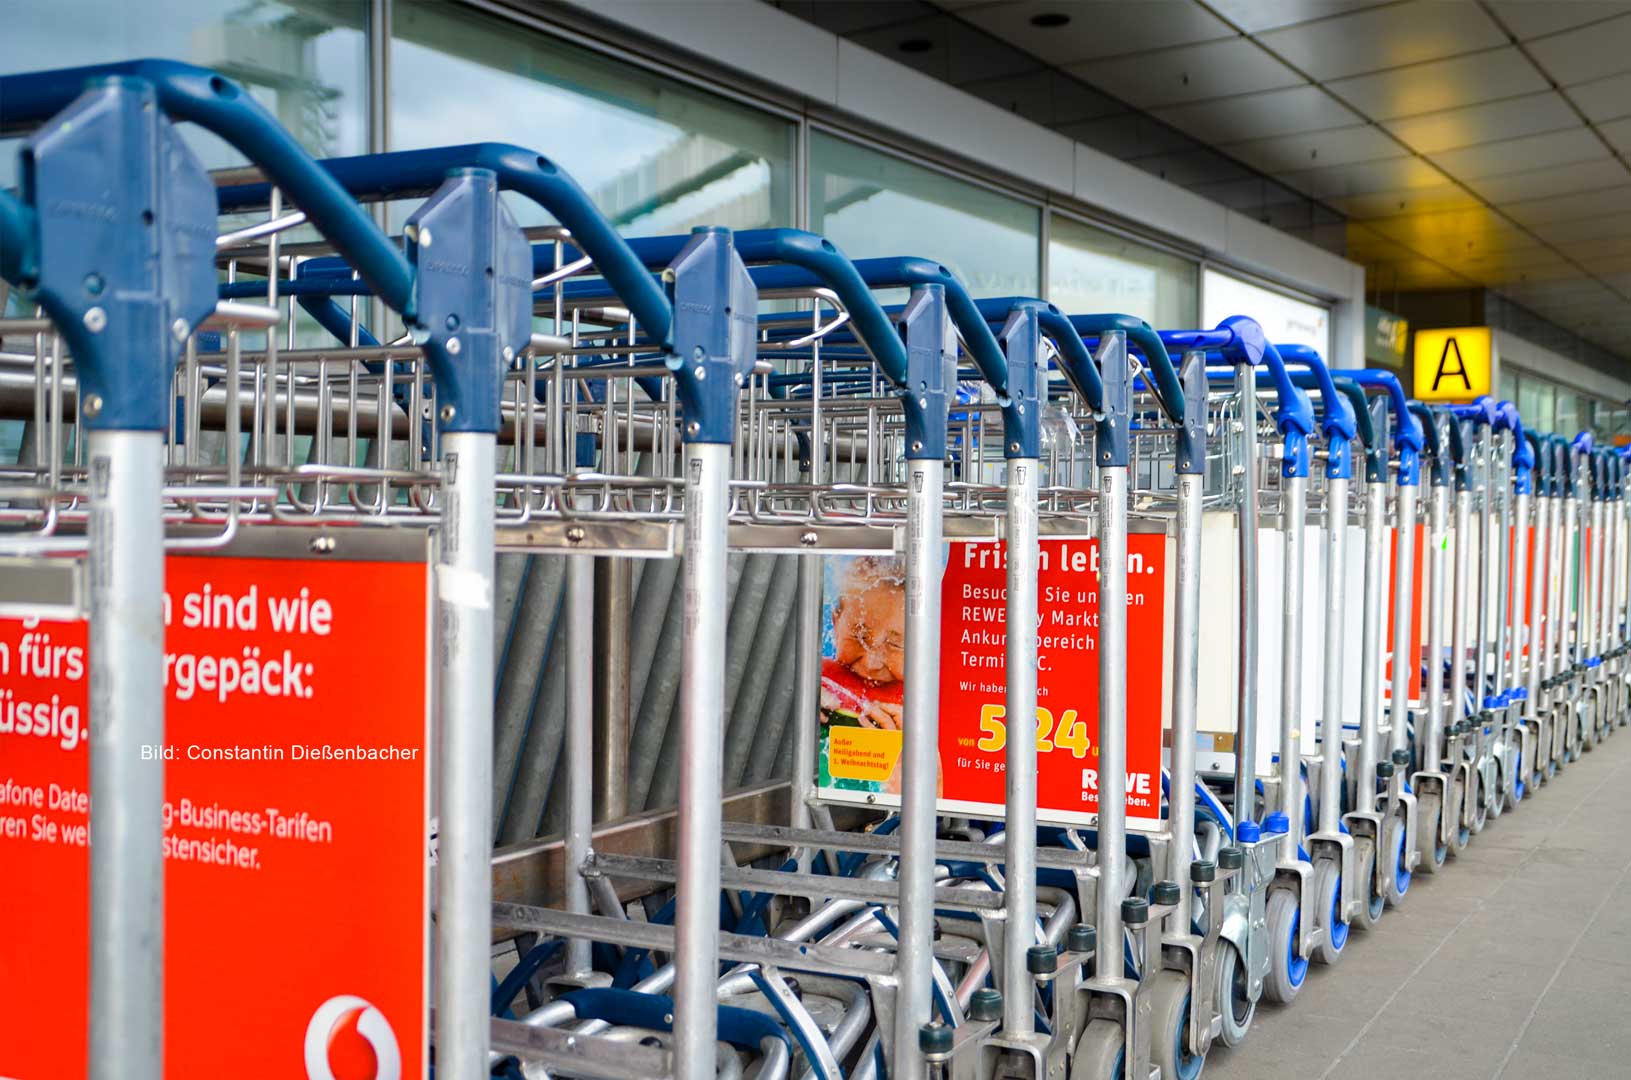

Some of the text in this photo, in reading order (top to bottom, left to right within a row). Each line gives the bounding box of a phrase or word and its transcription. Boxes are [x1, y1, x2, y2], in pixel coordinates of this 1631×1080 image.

[1431, 337, 1471, 391] A
[964, 542, 1154, 574] Frih lebn.
[962, 583, 1144, 605] Besuc Sie unen
[183, 582, 257, 631] sind
[268, 587, 333, 636] wie
[962, 606, 1006, 622] REWE
[1051, 610, 1099, 628] Markt
[19, 632, 84, 681] fürs
[163, 646, 314, 703] rgepäck:
[960, 651, 1052, 671] Termi C.
[960, 681, 976, 692] Wir
[0, 689, 89, 750] üssig.
[958, 737, 975, 748] von
[957, 756, 971, 768] für
[975, 759, 990, 770] Sie
[1081, 768, 1151, 795] RWE
[48, 783, 92, 814] Date
[31, 814, 57, 843] Sie
[162, 834, 261, 869] stensicher.
